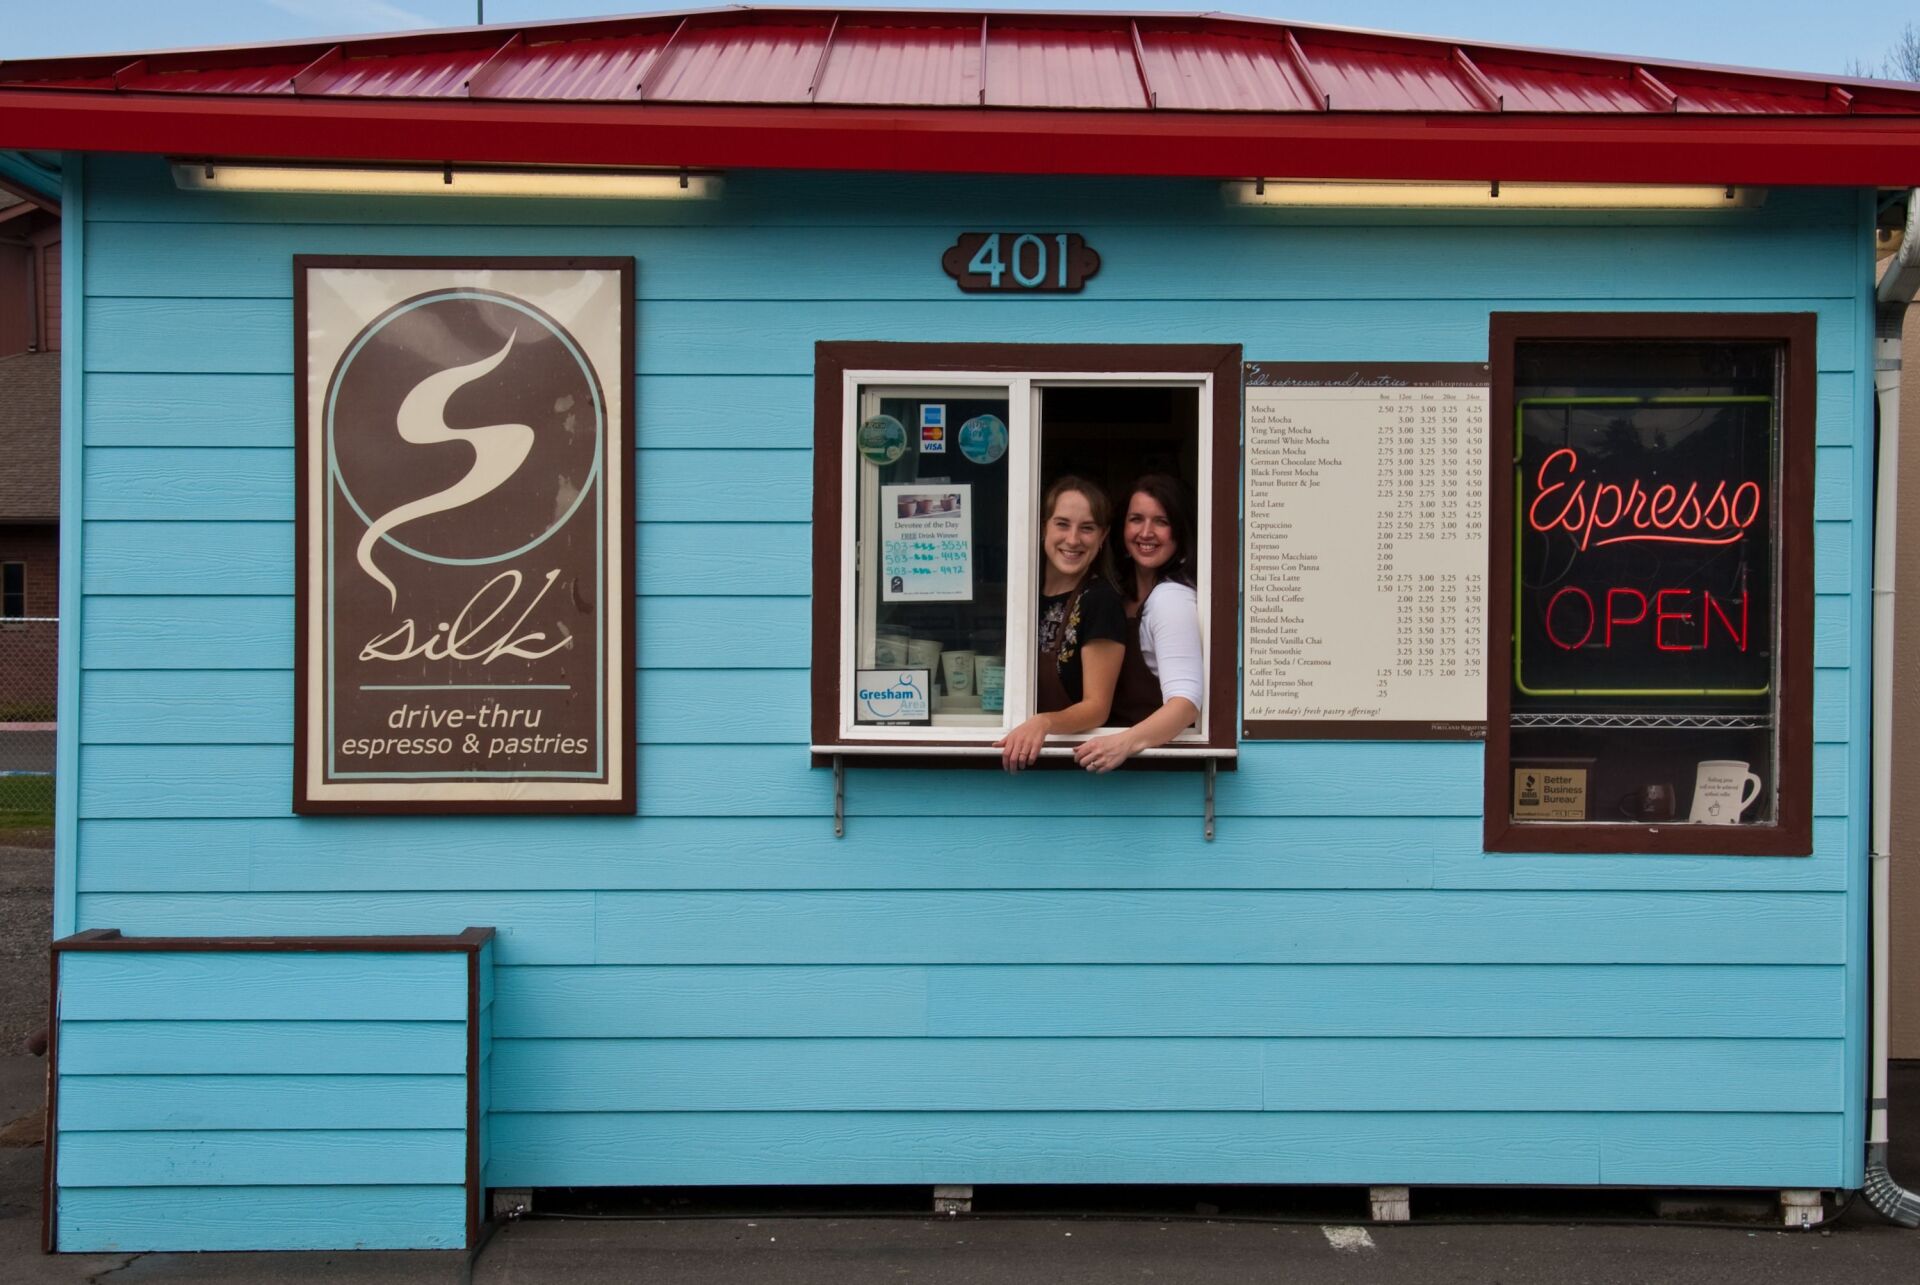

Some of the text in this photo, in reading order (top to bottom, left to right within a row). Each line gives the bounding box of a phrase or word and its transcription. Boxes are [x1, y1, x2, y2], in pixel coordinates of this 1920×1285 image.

[968, 233, 1067, 288] 401
[1251, 416, 1266, 424] Iced
[1282, 437, 1304, 445] White
[1281, 458, 1316, 466] Chocolate
[1251, 468, 1270, 476] Black
[1308, 479, 1320, 488] Joe
[1530, 448, 1760, 551] Espresso
[1268, 500, 1284, 508] Latte
[1250, 511, 1270, 519] Breve
[945, 522, 959, 530] Day
[1250, 521, 1292, 531] Cappuccino
[1250, 542, 1280, 552] Espresso
[1250, 553, 1280, 562] Espresso
[1281, 552, 1318, 561] Macchiato
[1250, 563, 1280, 573] Espresso
[1250, 574, 1267, 582] Chai
[1266, 584, 1301, 592] Chocolate
[1250, 594, 1304, 603] Silk Iced Coffee
[359, 569, 572, 665] silk
[1547, 586, 1747, 651] OPEN
[1250, 626, 1278, 634] Blended
[1250, 637, 1278, 645] Blended
[1280, 637, 1304, 645] Vanilla
[1250, 678, 1264, 687] Add
[1266, 679, 1295, 689] Espresso
[859, 688, 913, 699] Gresham
[1266, 689, 1299, 699] Flavoring
[901, 700, 926, 708] Area
[388, 704, 541, 728] drive-thru
[342, 734, 588, 759] espresso & pastries
[1544, 776, 1572, 784] Better
[1544, 785, 1582, 793] Business
[1544, 795, 1575, 803] Bureau
